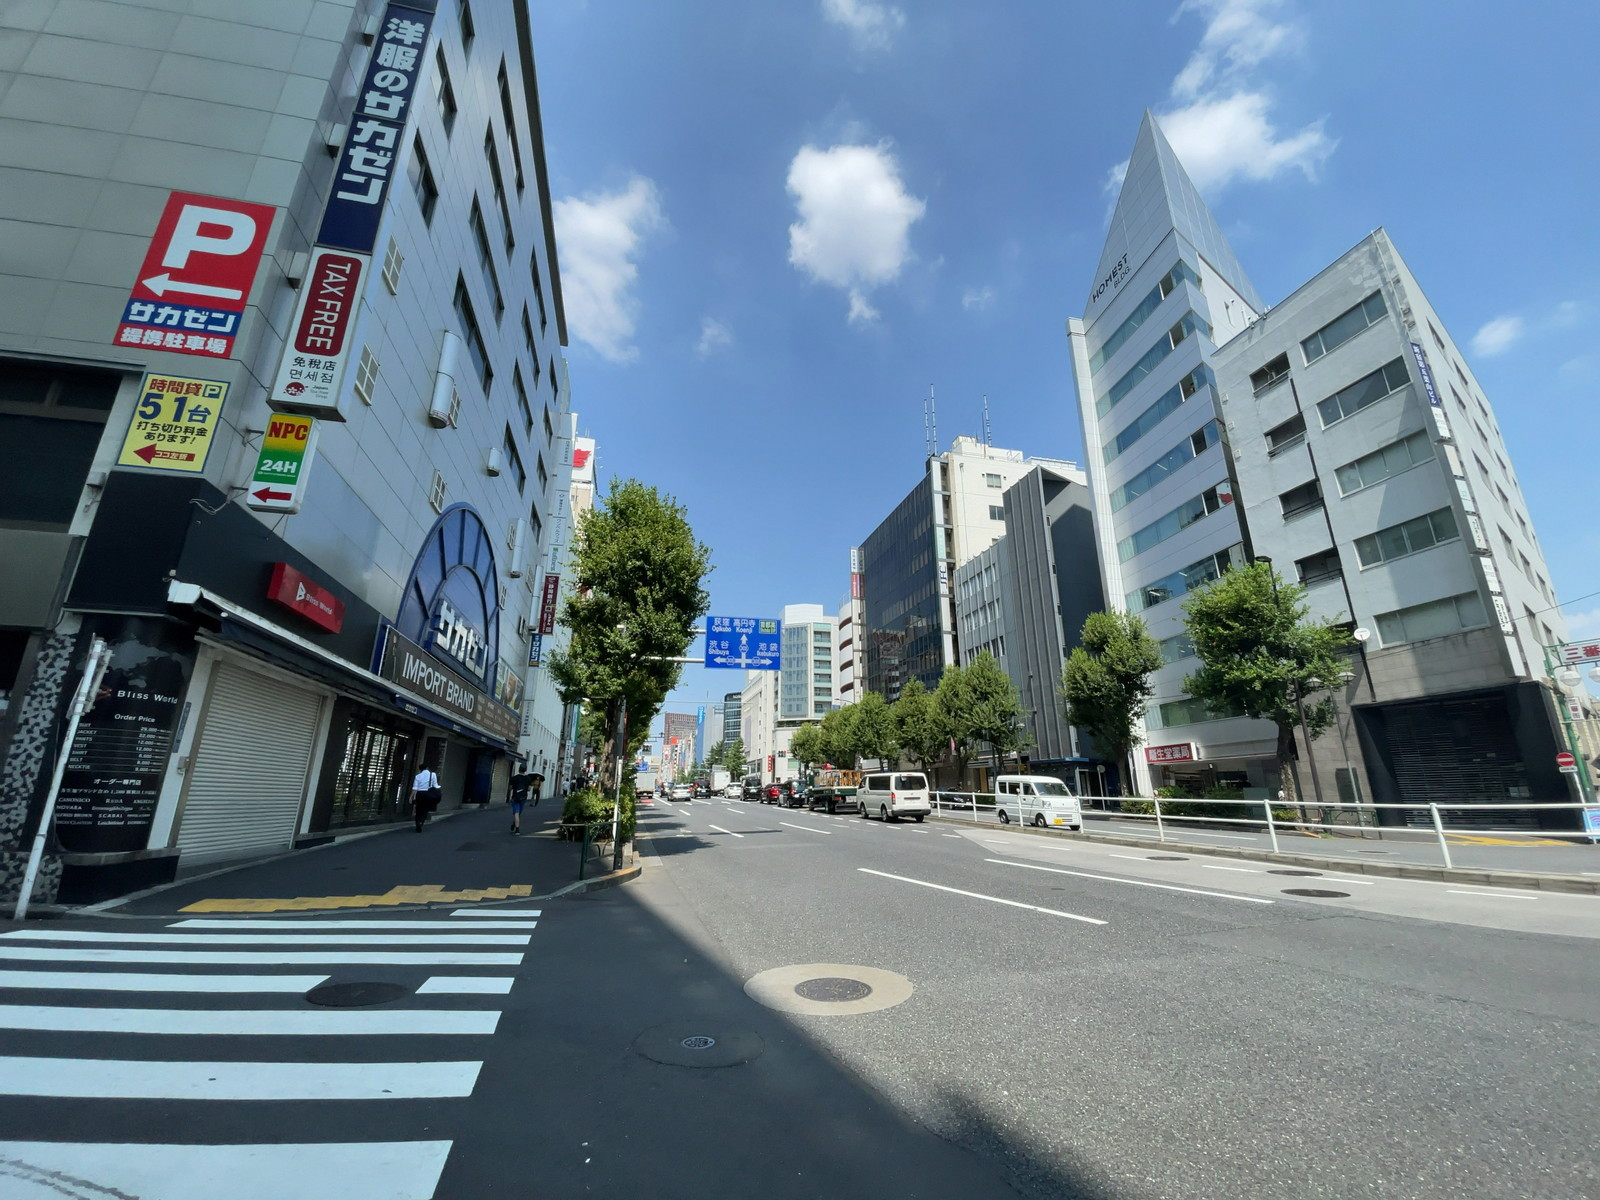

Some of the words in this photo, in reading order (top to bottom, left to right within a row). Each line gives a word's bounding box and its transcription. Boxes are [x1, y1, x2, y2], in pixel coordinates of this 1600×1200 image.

[337, 17, 426, 205] 洋服のサカゼン
[161, 204, 257, 269] P
[320, 262, 352, 297] TAX
[1092, 253, 1128, 303] HOMEST
[128, 302, 237, 333] サカゼン
[305, 298, 342, 350] FREE
[120, 326, 227, 355] 提携駐車場
[149, 378, 204, 396] 時間貸
[289, 369, 334, 384] 면세점
[136, 421, 208, 437] 打ち切り料金
[268, 421, 309, 441] NPC
[260, 459, 297, 474] 24H
[436, 600, 489, 680] サカゼン
[117, 690, 149, 700] Bliss
[153, 694, 178, 704] World
[402, 652, 447, 698] IMPORT
[445, 679, 475, 713] BRAND
[114, 713, 136, 721] Order
[138, 715, 156, 723] Price
[93, 778, 142, 786] オーダー専門店
